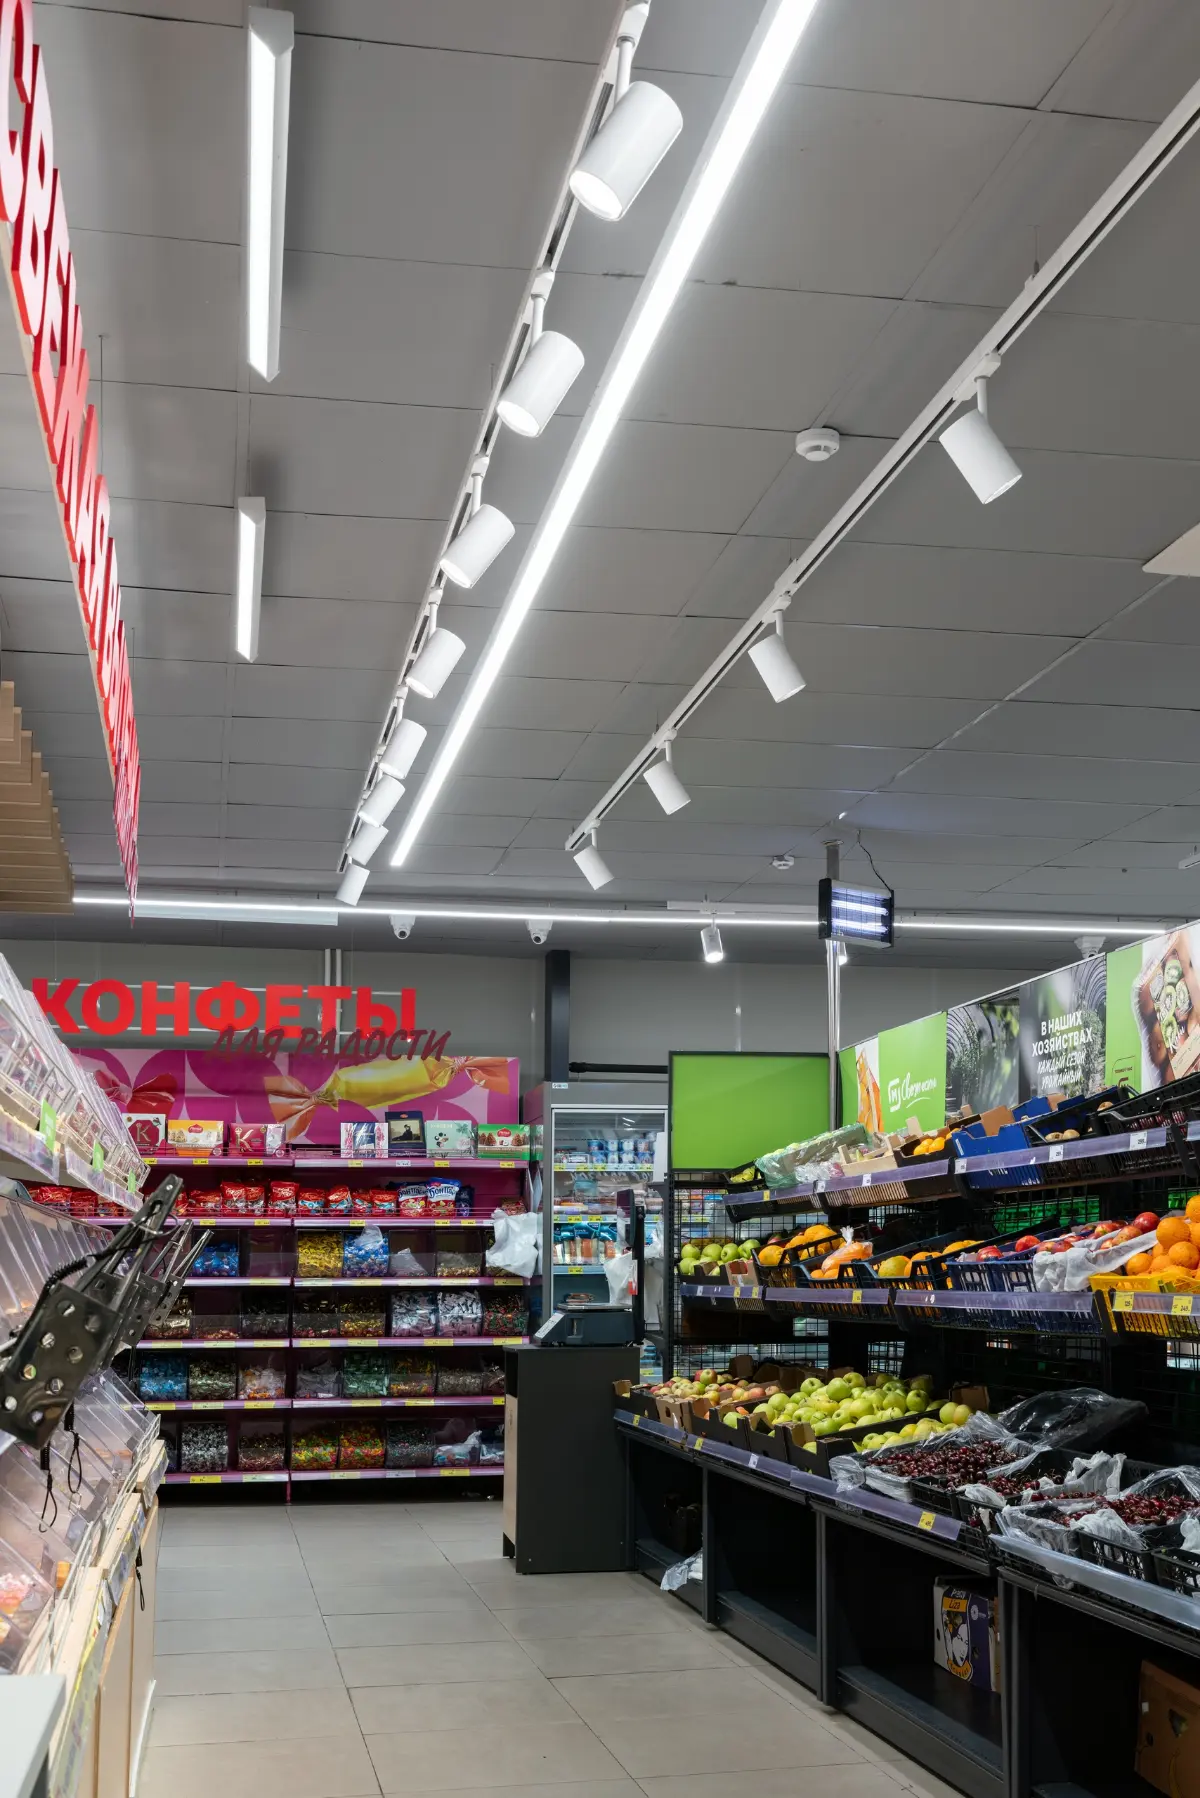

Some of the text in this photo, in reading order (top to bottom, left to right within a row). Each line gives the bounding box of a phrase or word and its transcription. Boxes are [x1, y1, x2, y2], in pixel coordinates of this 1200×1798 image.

[32, 977, 416, 1040] КОНФЕТЫ
[1041, 1010, 1083, 1036] В НАШИХ
[205, 1026, 452, 1065] ДЛЯ РАДОСТИ
[1031, 1027, 1093, 1057] ХОЗЯЙСТВАХ
[1037, 1049, 1087, 1075] КАЖДЫЙ СЕЗОН
[1041, 1066, 1083, 1089] УРОЖАЙНЫЙ
